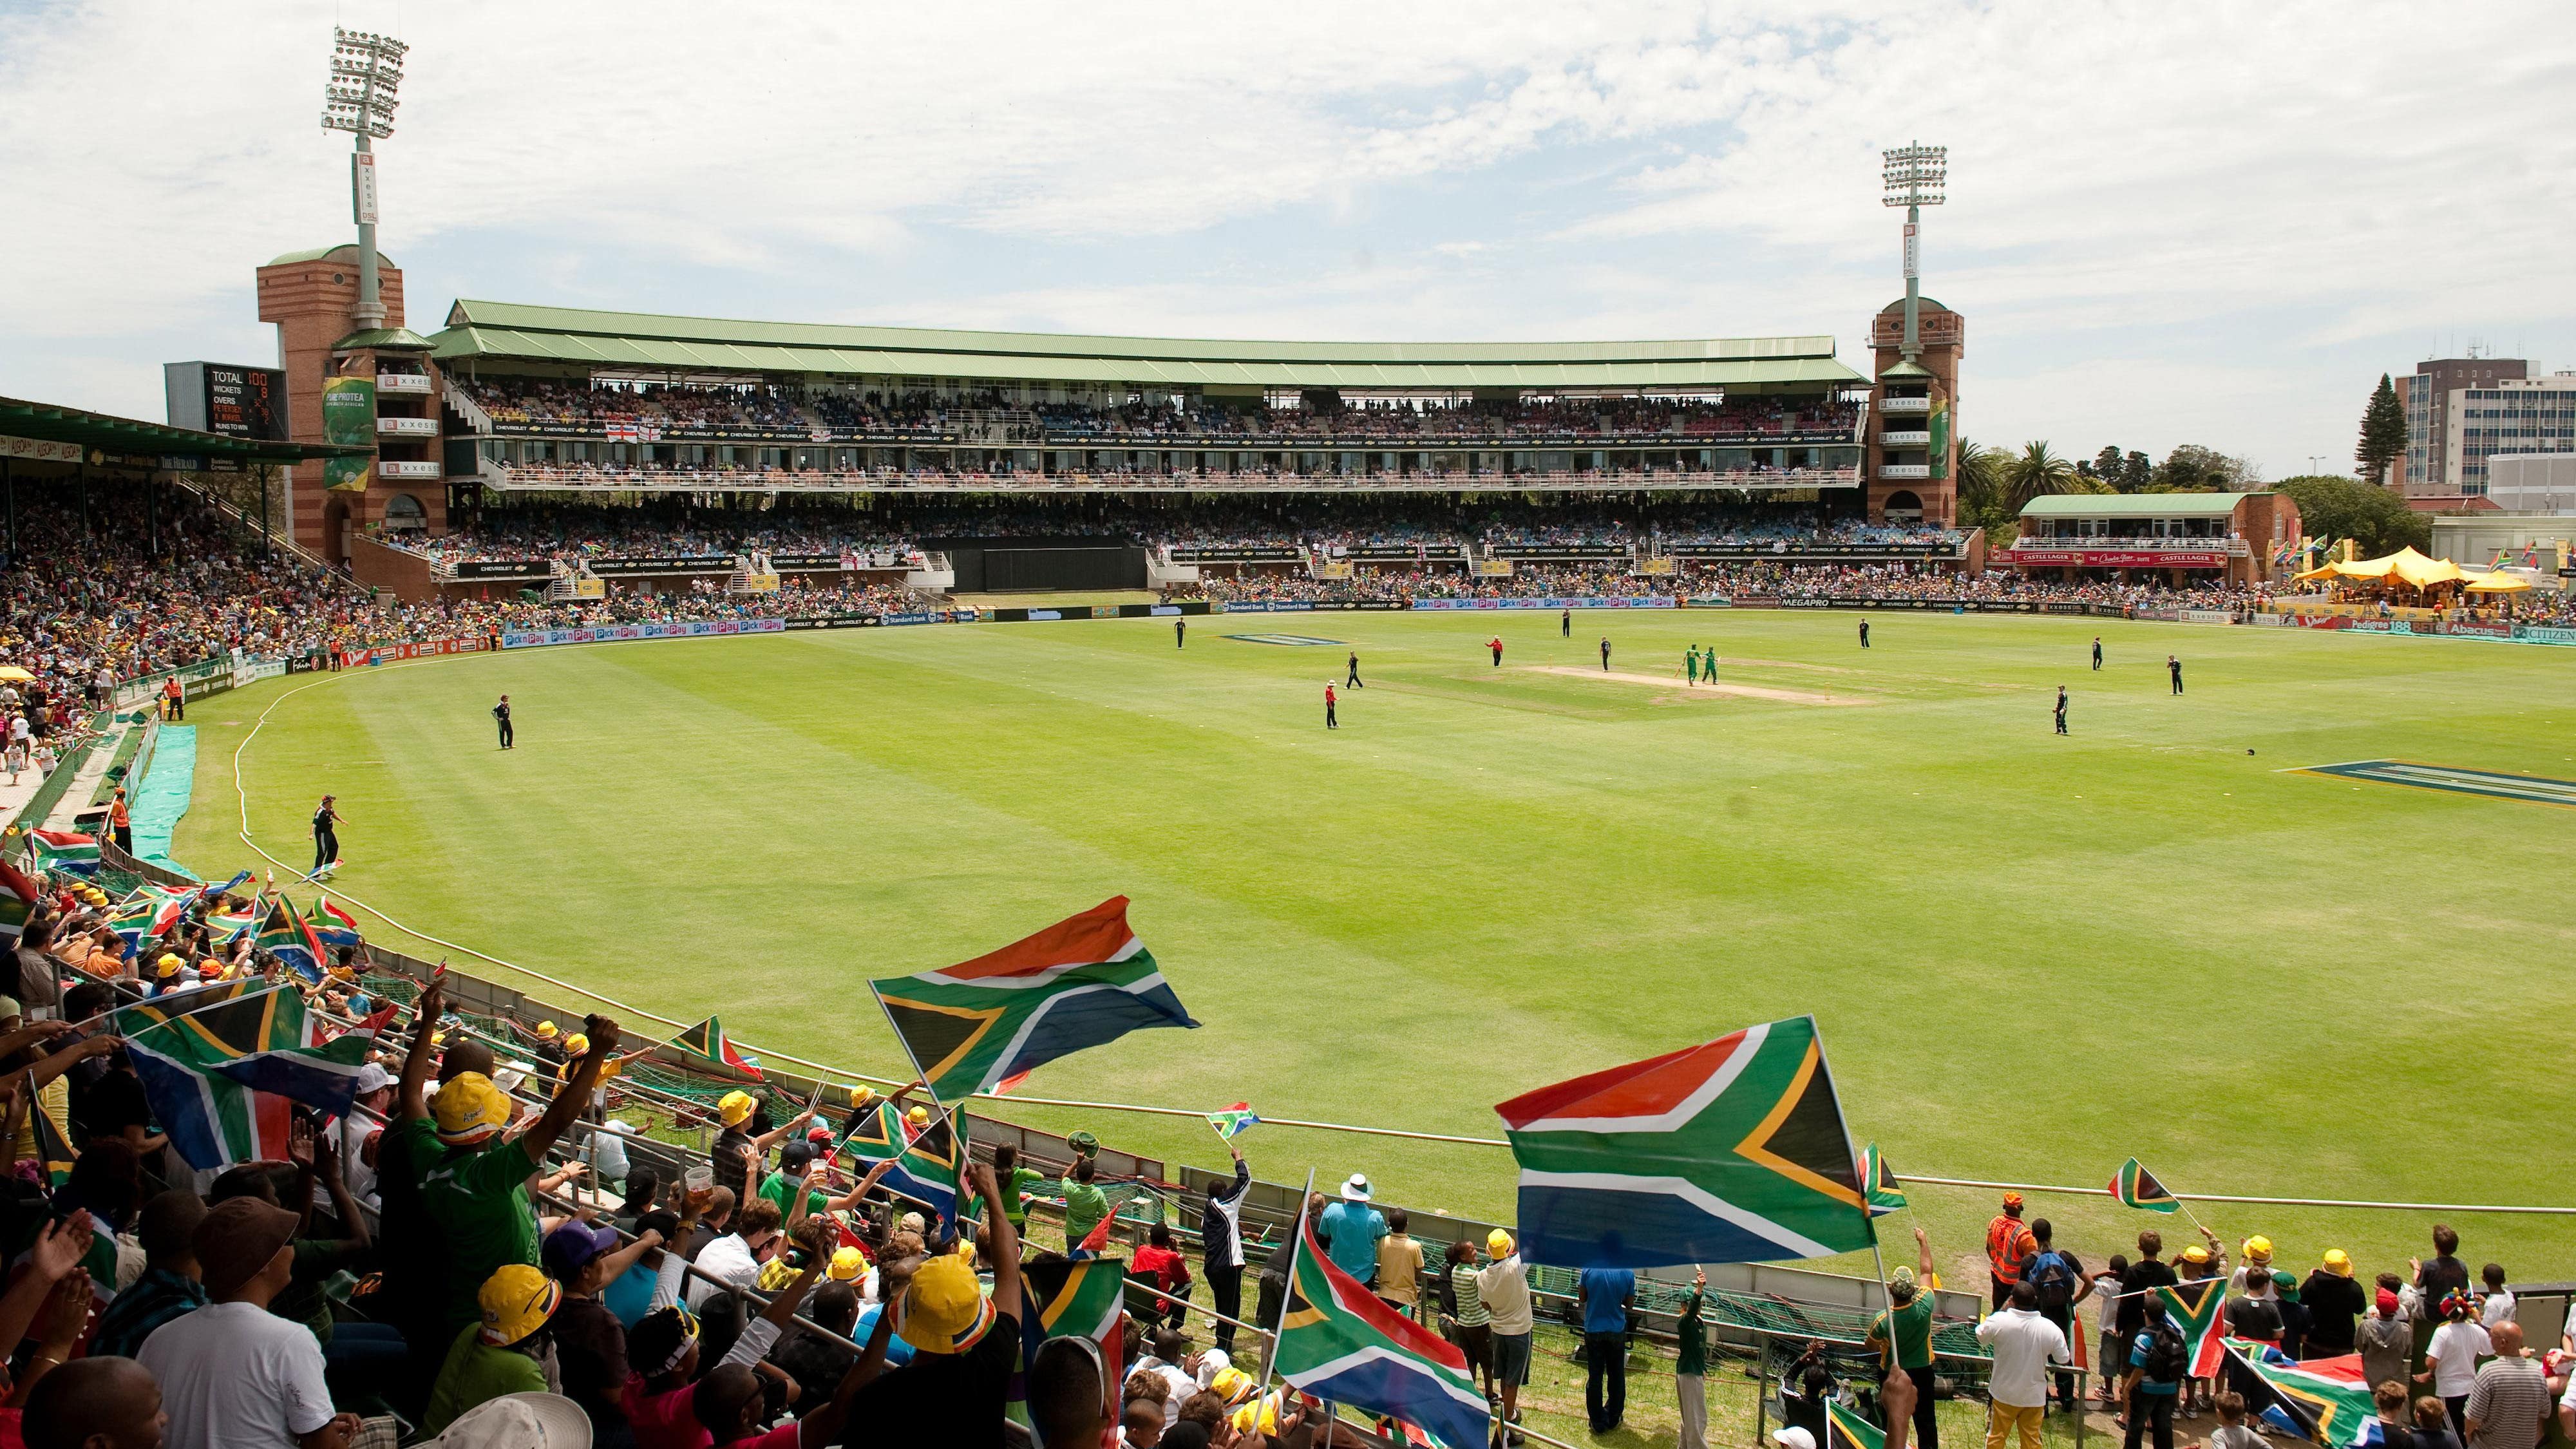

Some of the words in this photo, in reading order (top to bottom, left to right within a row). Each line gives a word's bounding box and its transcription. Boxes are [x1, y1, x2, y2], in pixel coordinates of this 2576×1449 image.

[213, 372, 243, 383] TOTAL
[249, 372, 267, 386] 100
[214, 385, 241, 394] WICKETS
[214, 396, 236, 404] OVERS
[339, 393, 364, 402] PROTEA
[12, 439, 26, 454] ALGOA
[37, 442, 52, 457] ALGOA
[62, 445, 76, 459] ALGOA
[1478, 600, 1497, 609] Pay
[1611, 598, 1630, 607] Pay
[1655, 598, 1671, 607] Pay
[670, 625, 686, 634] Pay
[717, 621, 739, 632] Pay
[764, 620, 781, 630] Pay
[2353, 620, 2389, 630] Pedigree
[2390, 621, 2411, 632] 188
[2450, 624, 2494, 635] Abacus
[574, 630, 594, 641] Pay
[621, 628, 638, 637] Pay
[2530, 630, 2576, 639] CITIZEN
[528, 633, 544, 644] Pay
